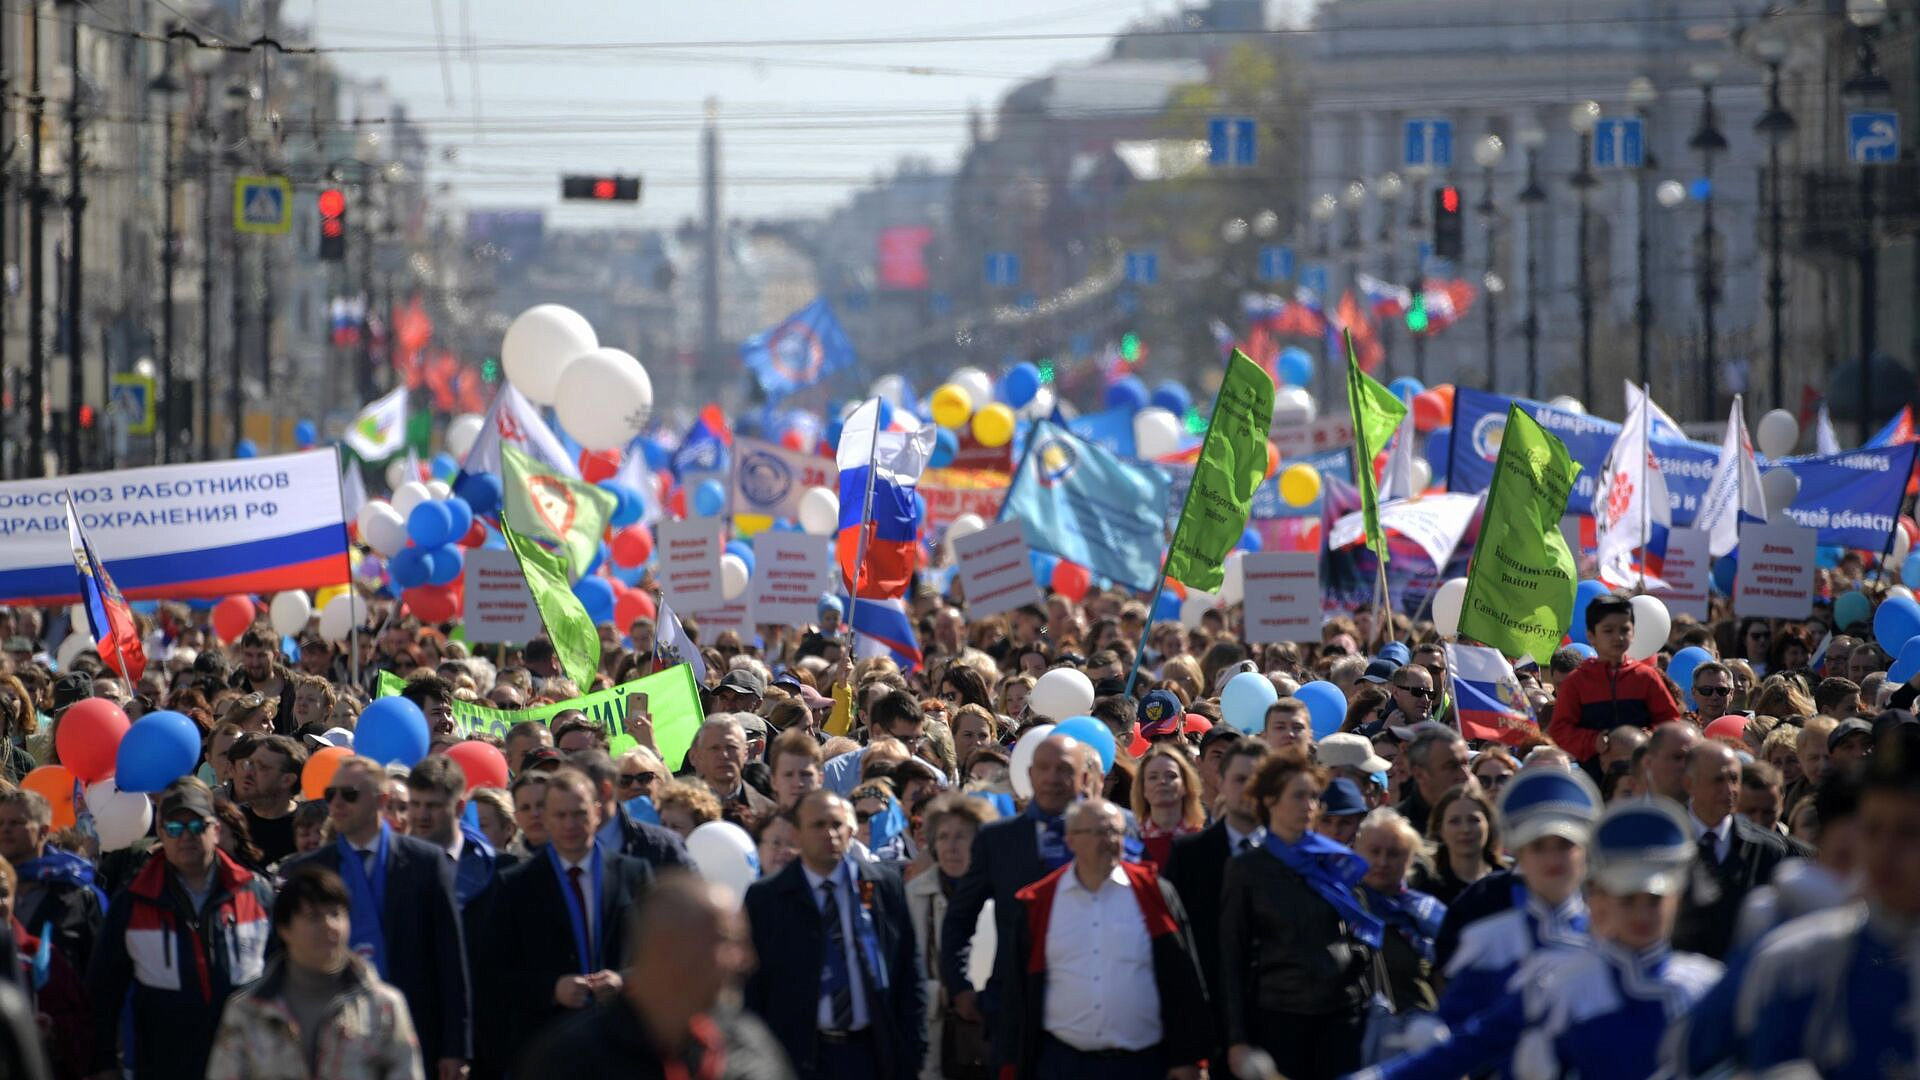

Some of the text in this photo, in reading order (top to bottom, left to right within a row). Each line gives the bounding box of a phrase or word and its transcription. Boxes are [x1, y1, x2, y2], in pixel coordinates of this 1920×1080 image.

[122, 472, 289, 500] РАБОТНИКОВ
[246, 501, 278, 519] РФ
[1501, 572, 1539, 591] район
